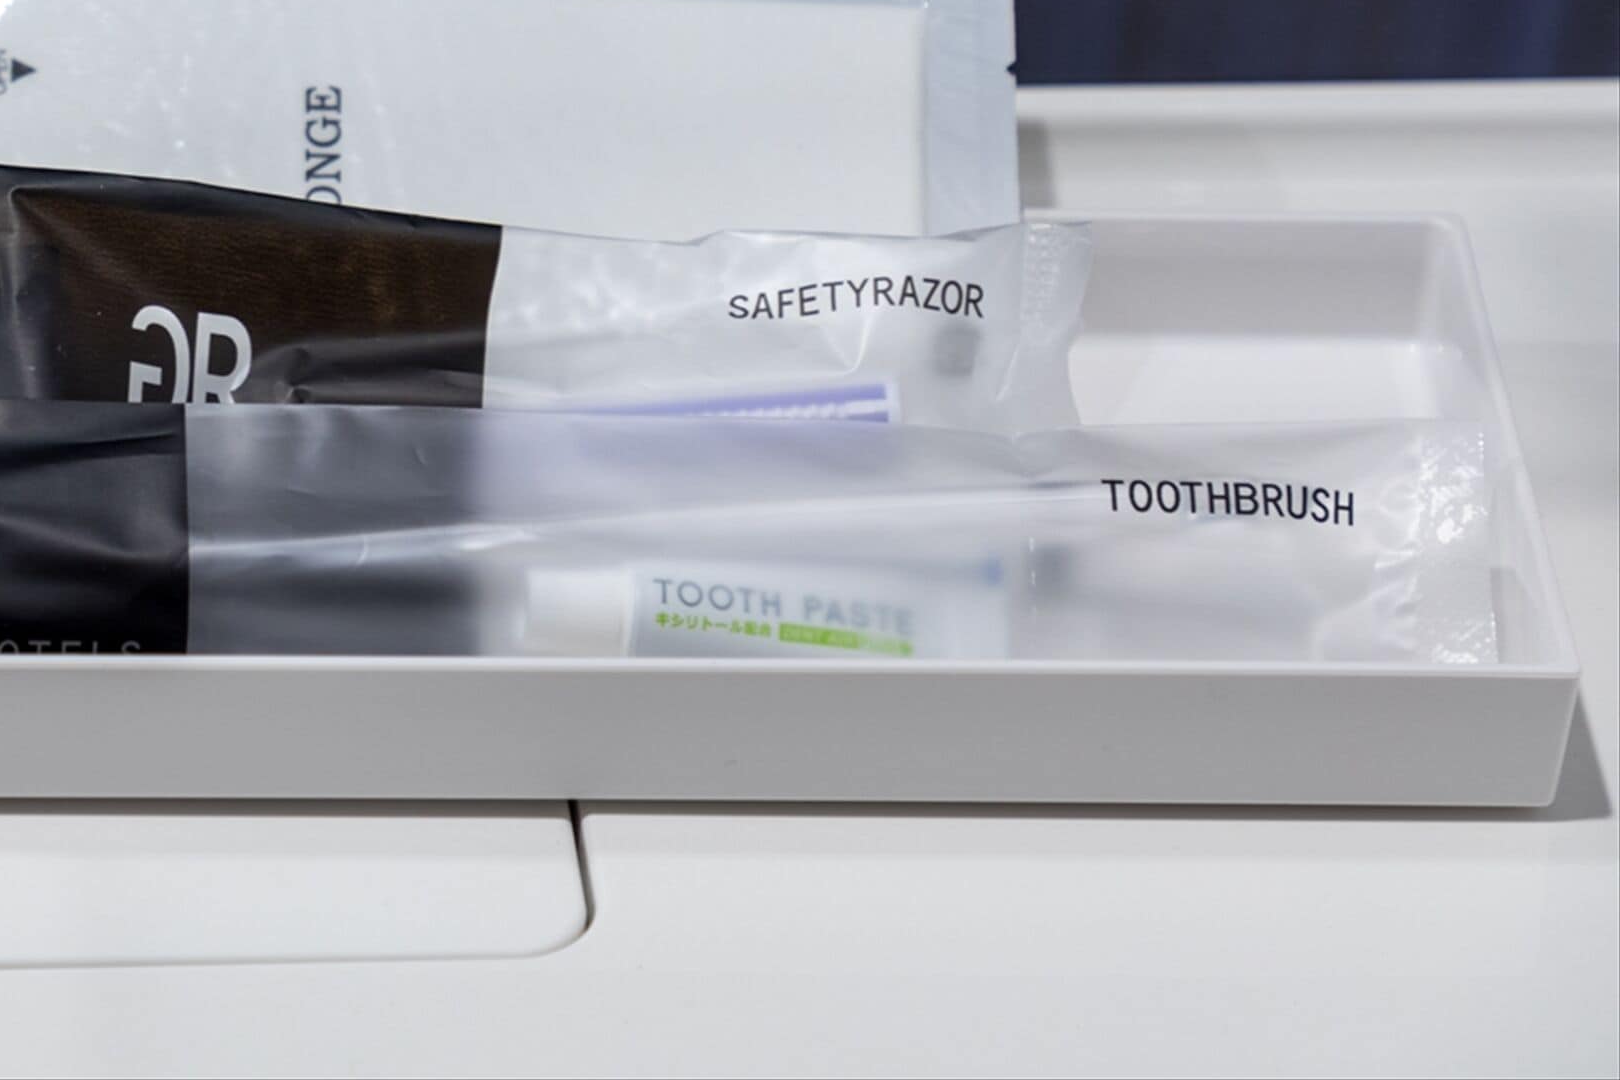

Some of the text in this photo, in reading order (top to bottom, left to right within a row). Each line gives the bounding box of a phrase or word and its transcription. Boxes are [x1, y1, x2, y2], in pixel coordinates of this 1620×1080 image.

[727, 274, 985, 319] SAFETYRAZOR
[1100, 478, 1354, 526] TOOTHBRUSH
[652, 577, 915, 636] TOOTH PASTE
